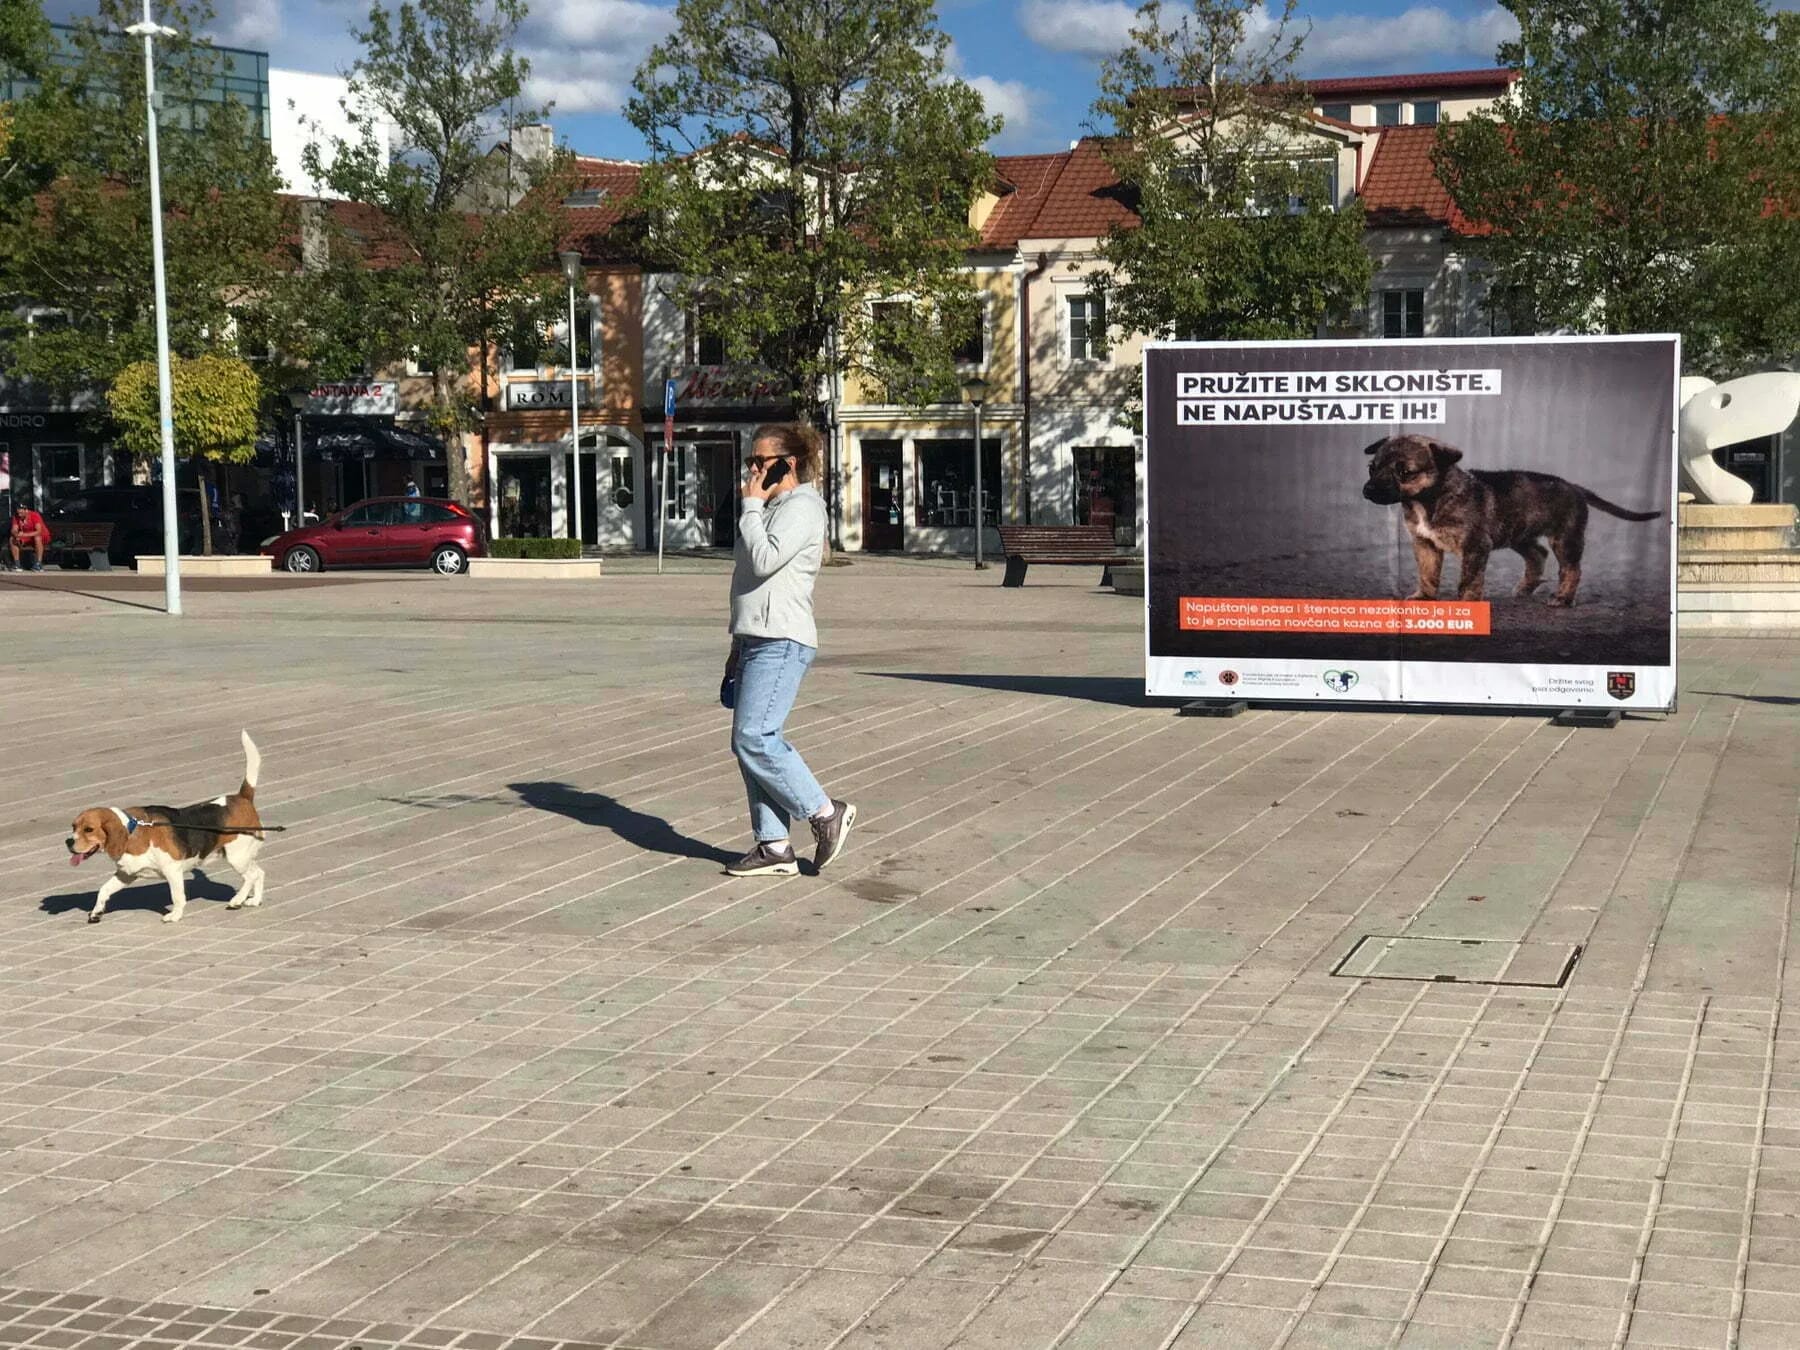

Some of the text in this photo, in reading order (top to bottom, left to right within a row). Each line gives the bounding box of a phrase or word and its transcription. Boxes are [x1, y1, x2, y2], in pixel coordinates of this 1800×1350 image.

[1183, 368, 1491, 394] PRUŽITE IM SKLONIŠTE.
[373, 385, 383, 397] 2
[1183, 399, 1438, 421] NE NAPUŠTAJTE IH!
[1186, 602, 1259, 614] Napuštanje
[1261, 605, 1294, 615] pasa
[1303, 603, 1356, 615] štenaca
[1359, 605, 1430, 617] nezakonito
[1432, 606, 1445, 618] je
[1455, 608, 1471, 617] za
[1186, 615, 1474, 630] to je propisana novčana kazna do 3.000 EUR
